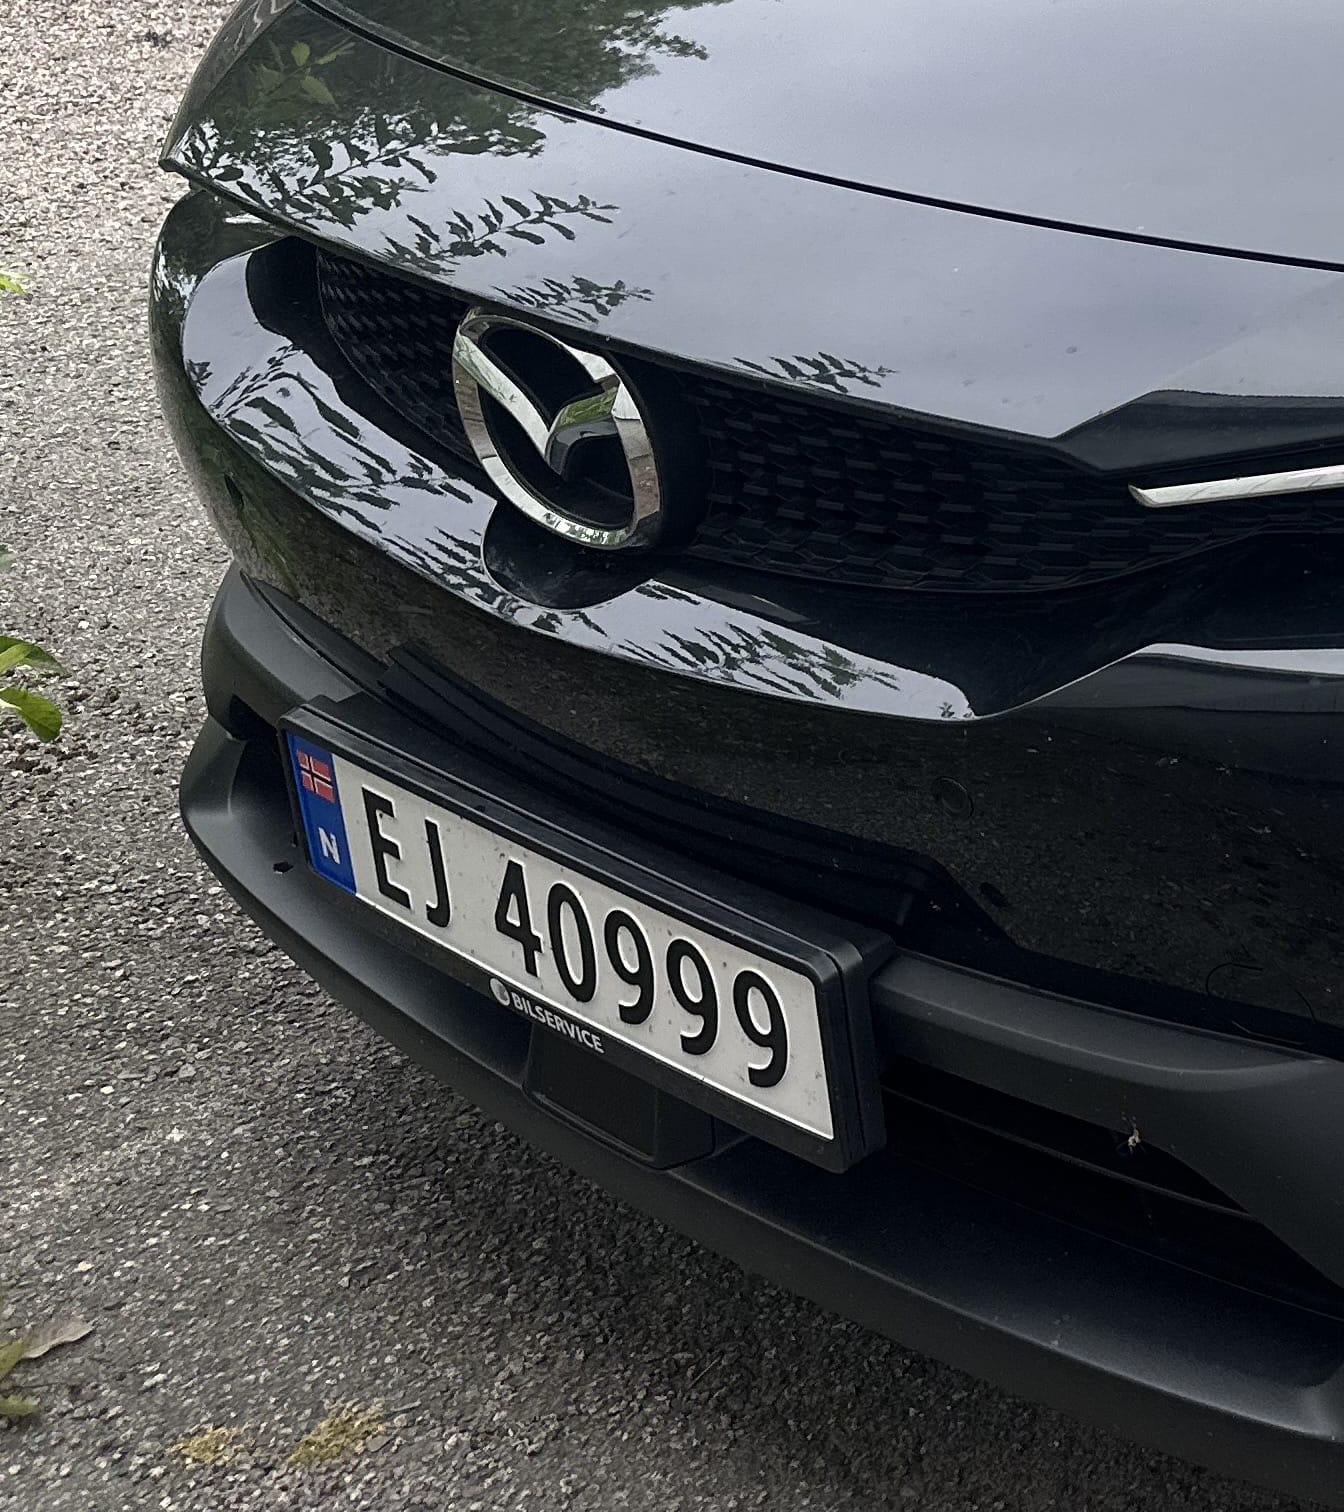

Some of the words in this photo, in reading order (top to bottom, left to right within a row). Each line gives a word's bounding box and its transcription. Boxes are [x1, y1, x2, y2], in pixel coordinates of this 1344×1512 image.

[318, 825, 340, 866] N
[361, 785, 452, 929] EJ
[494, 859, 789, 1088] 40999
[511, 993, 604, 1054] BILSERVICE
